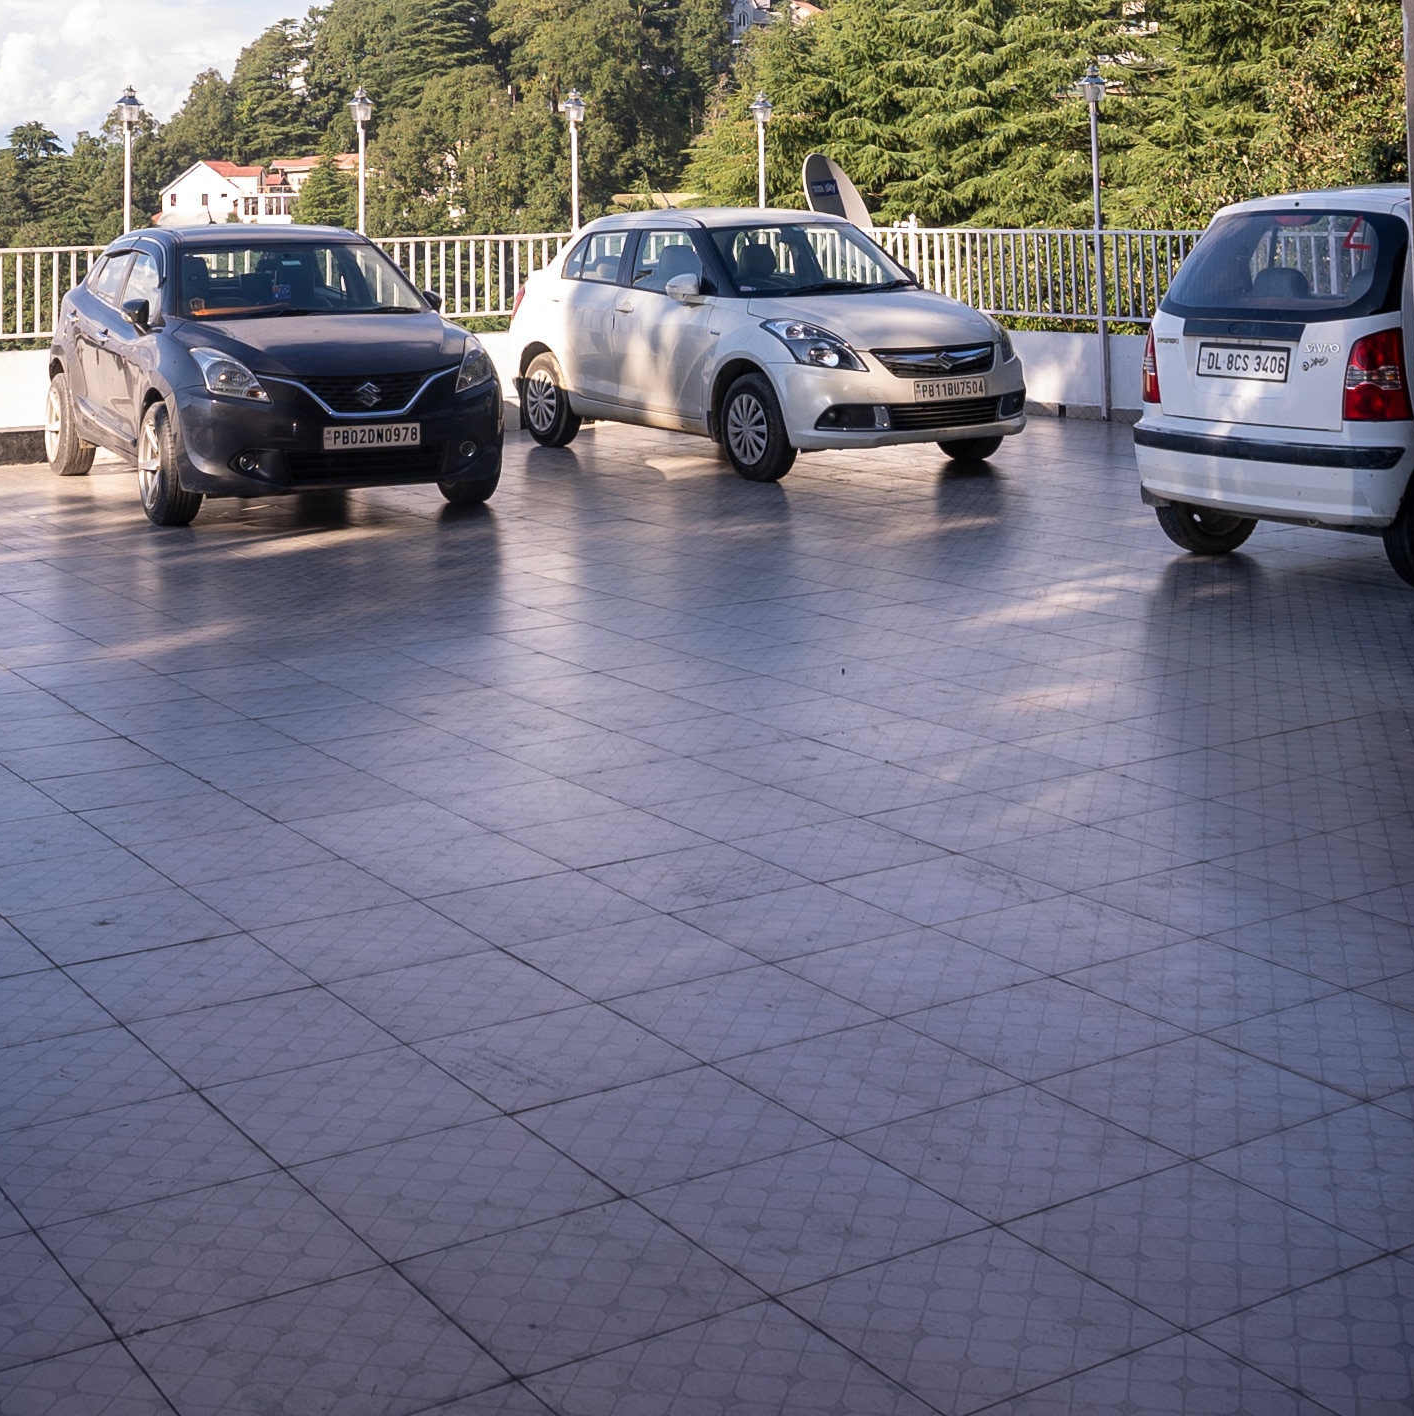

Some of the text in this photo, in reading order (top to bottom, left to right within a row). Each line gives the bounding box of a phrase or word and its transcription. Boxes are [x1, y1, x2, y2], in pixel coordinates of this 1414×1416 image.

[1206, 352, 1222, 371] DL
[1226, 353, 1249, 372] 8CS
[1253, 355, 1286, 374] 3406
[921, 380, 984, 398] PB11BU7504
[332, 426, 419, 446] PB02DN0978
